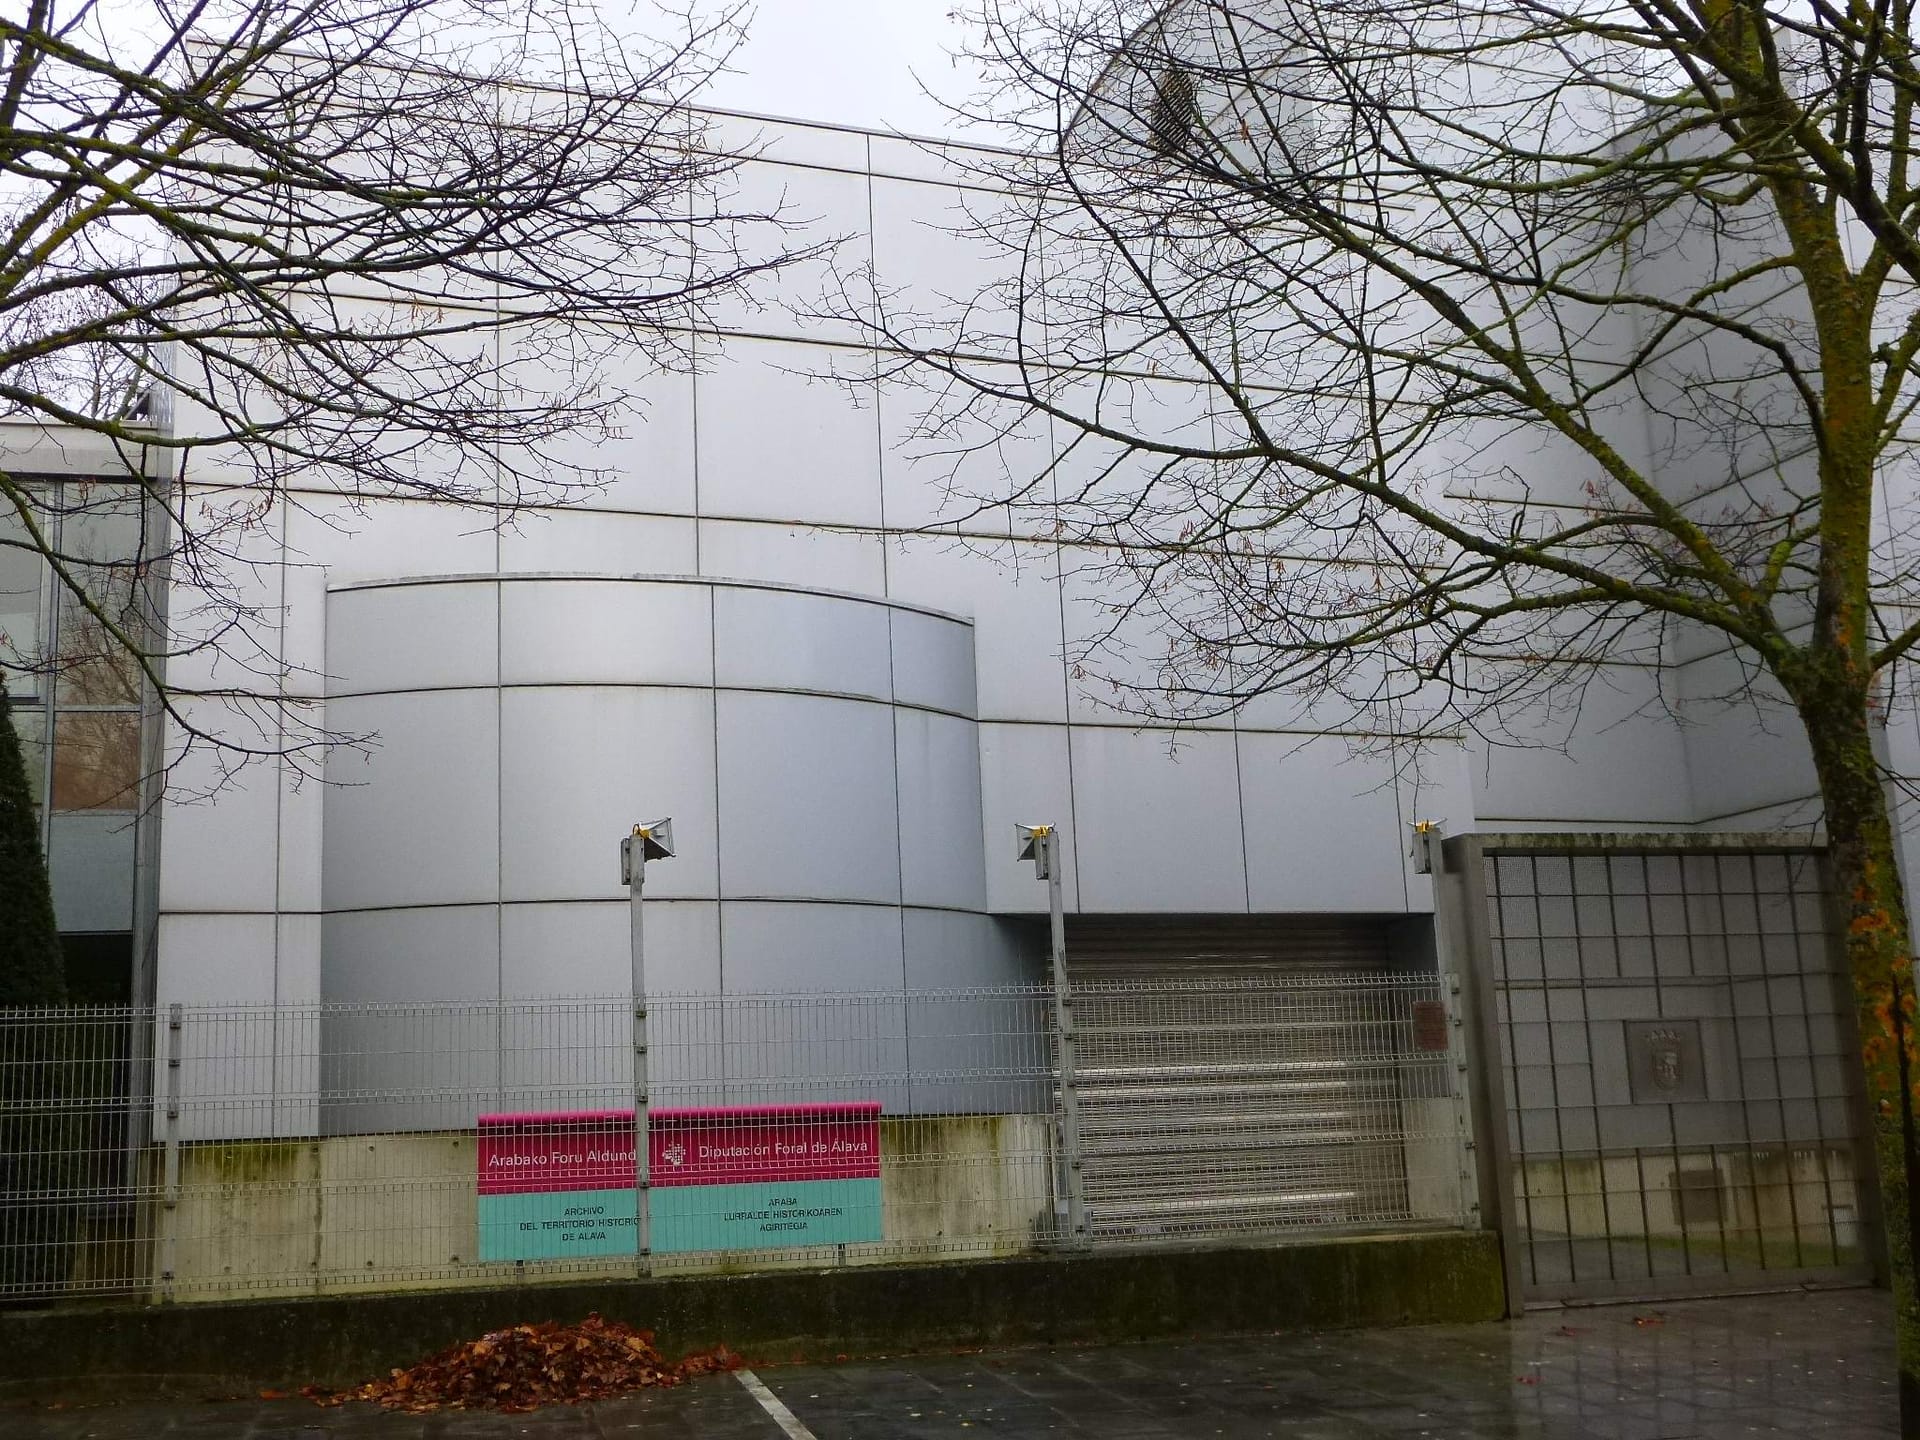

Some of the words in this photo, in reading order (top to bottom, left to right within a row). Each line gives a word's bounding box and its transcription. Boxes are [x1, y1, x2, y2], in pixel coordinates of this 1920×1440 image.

[699, 1143, 770, 1160] Diputación
[775, 1142, 807, 1155] Foral
[812, 1141, 828, 1154] de
[488, 1152, 548, 1167] Arabako
[552, 1151, 583, 1165] Foru
[587, 1149, 638, 1163] Aldund
[768, 1198, 798, 1207] ARABA
[564, 1206, 605, 1216] ARCHIVO
[724, 1210, 770, 1221] LURRALDE
[519, 1222, 538, 1231] DEL
[541, 1219, 595, 1230] TERRITORIO
[562, 1233, 575, 1241] DE
